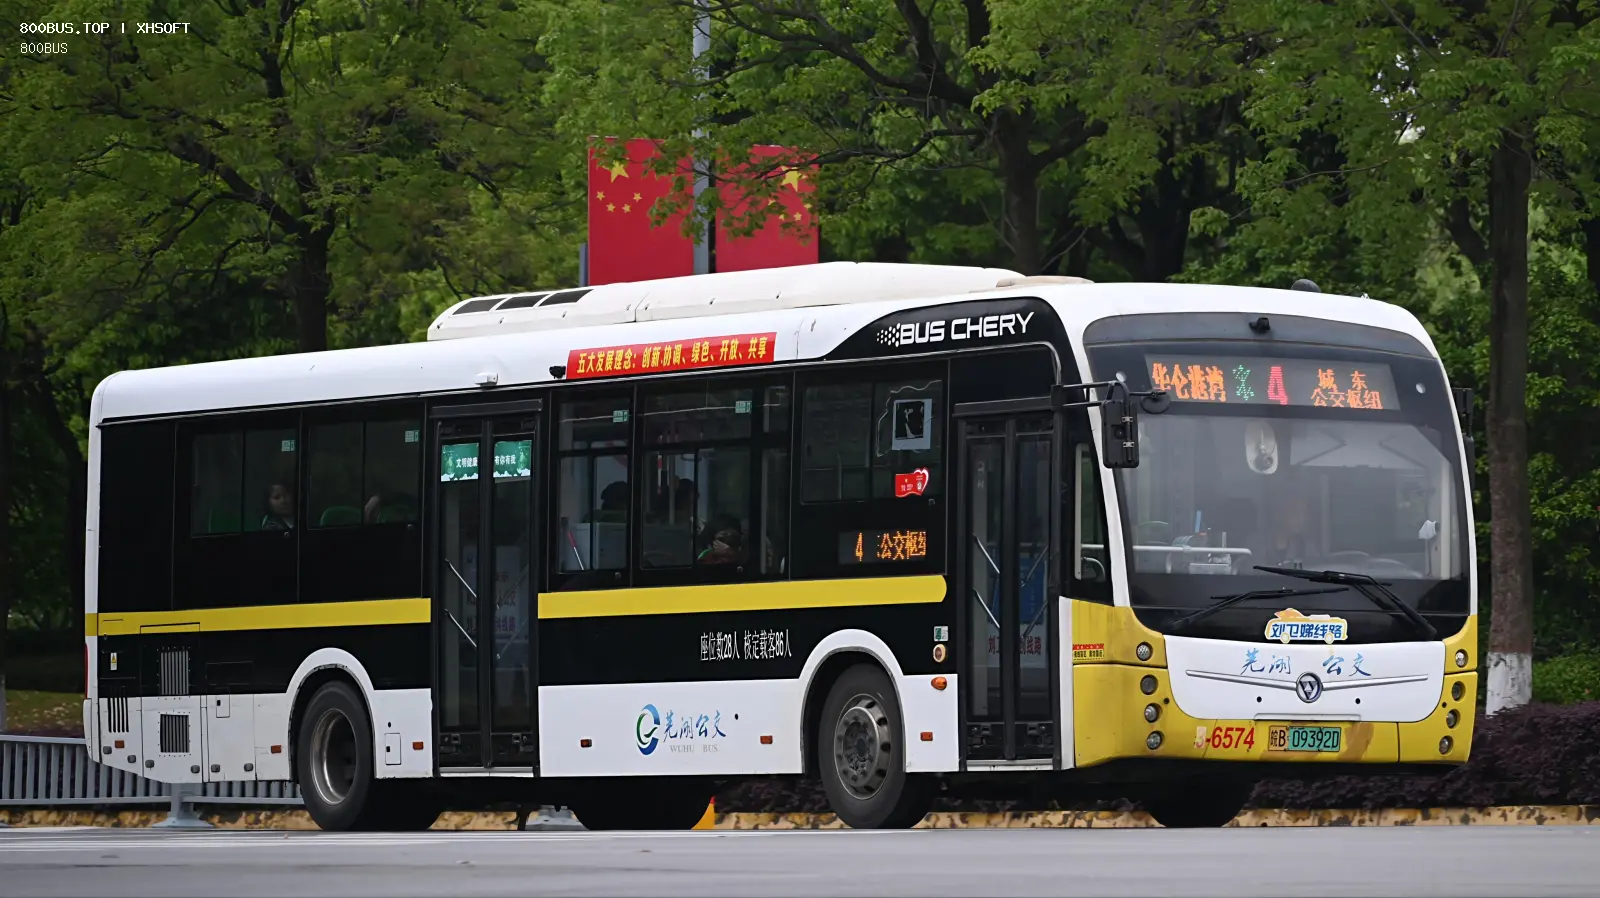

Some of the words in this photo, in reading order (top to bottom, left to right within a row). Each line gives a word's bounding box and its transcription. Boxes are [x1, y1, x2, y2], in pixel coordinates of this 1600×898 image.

[899, 320, 946, 345] BUS
[951, 312, 1035, 340] CHERY
[1267, 366, 1289, 406] 4
[1310, 388, 1384, 410] 公交枢纽
[855, 532, 864, 562] 4
[700, 631, 740, 661] 座位数28人
[743, 629, 792, 659] 核定载客86人
[669, 744, 695, 753] WUHU
[702, 744, 718, 753] BUS
